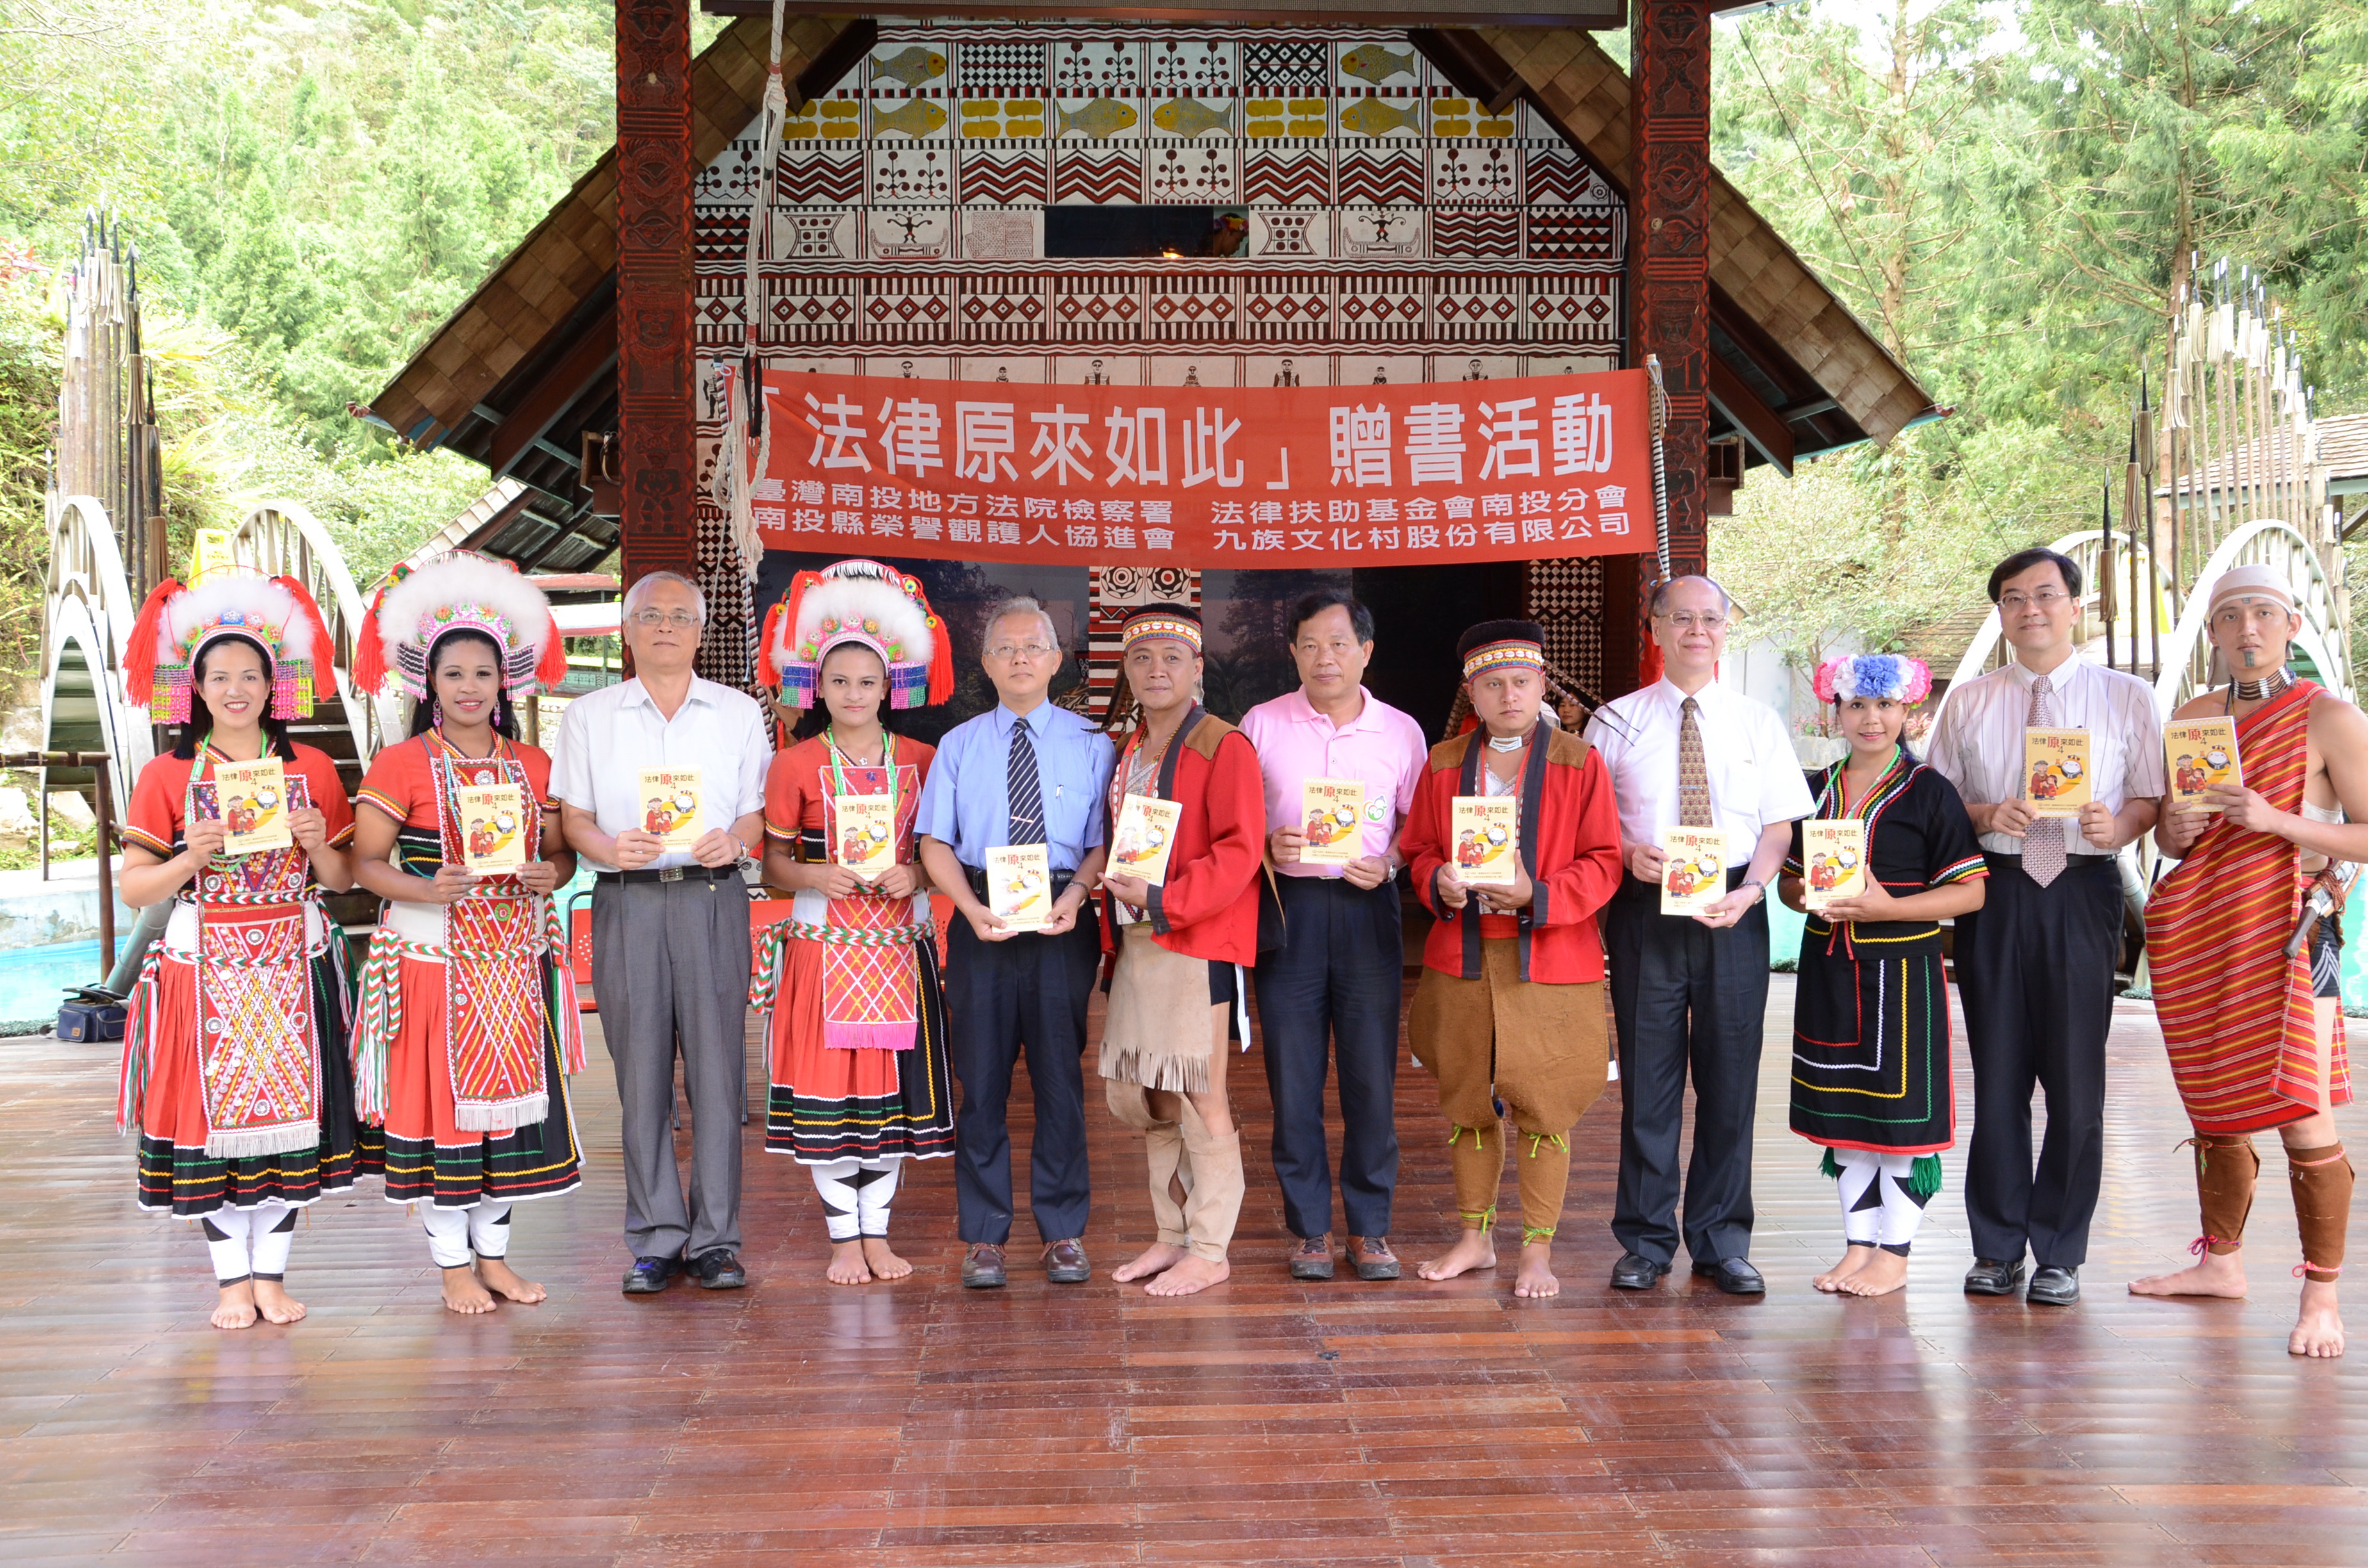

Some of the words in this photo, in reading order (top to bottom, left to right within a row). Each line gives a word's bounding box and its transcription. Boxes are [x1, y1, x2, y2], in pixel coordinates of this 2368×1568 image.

[753, 478, 1173, 524] 臺灣南投地方法院檢察署
[1210, 484, 1628, 525] 法律扶助基金會南投分會
[753, 507, 1174, 550] 南投縣榮譽觀護人協進會
[1213, 512, 1631, 551] 九族文化村股份有限公司
[2171, 728, 2226, 740] 法律原來如此
[2032, 736, 2083, 748] 法律原來如此
[222, 768, 275, 781] 法律原來如此
[645, 774, 695, 785] 法律原來如此
[1309, 786, 1357, 797] 法律原來如此
[467, 793, 514, 804] 法律原來如此
[842, 803, 888, 814] 法律原來如此
[1459, 805, 1509, 816] 法律原來如此
[1809, 828, 1857, 840] 法律原來如此
[1670, 835, 1720, 846] 法律原來如此
